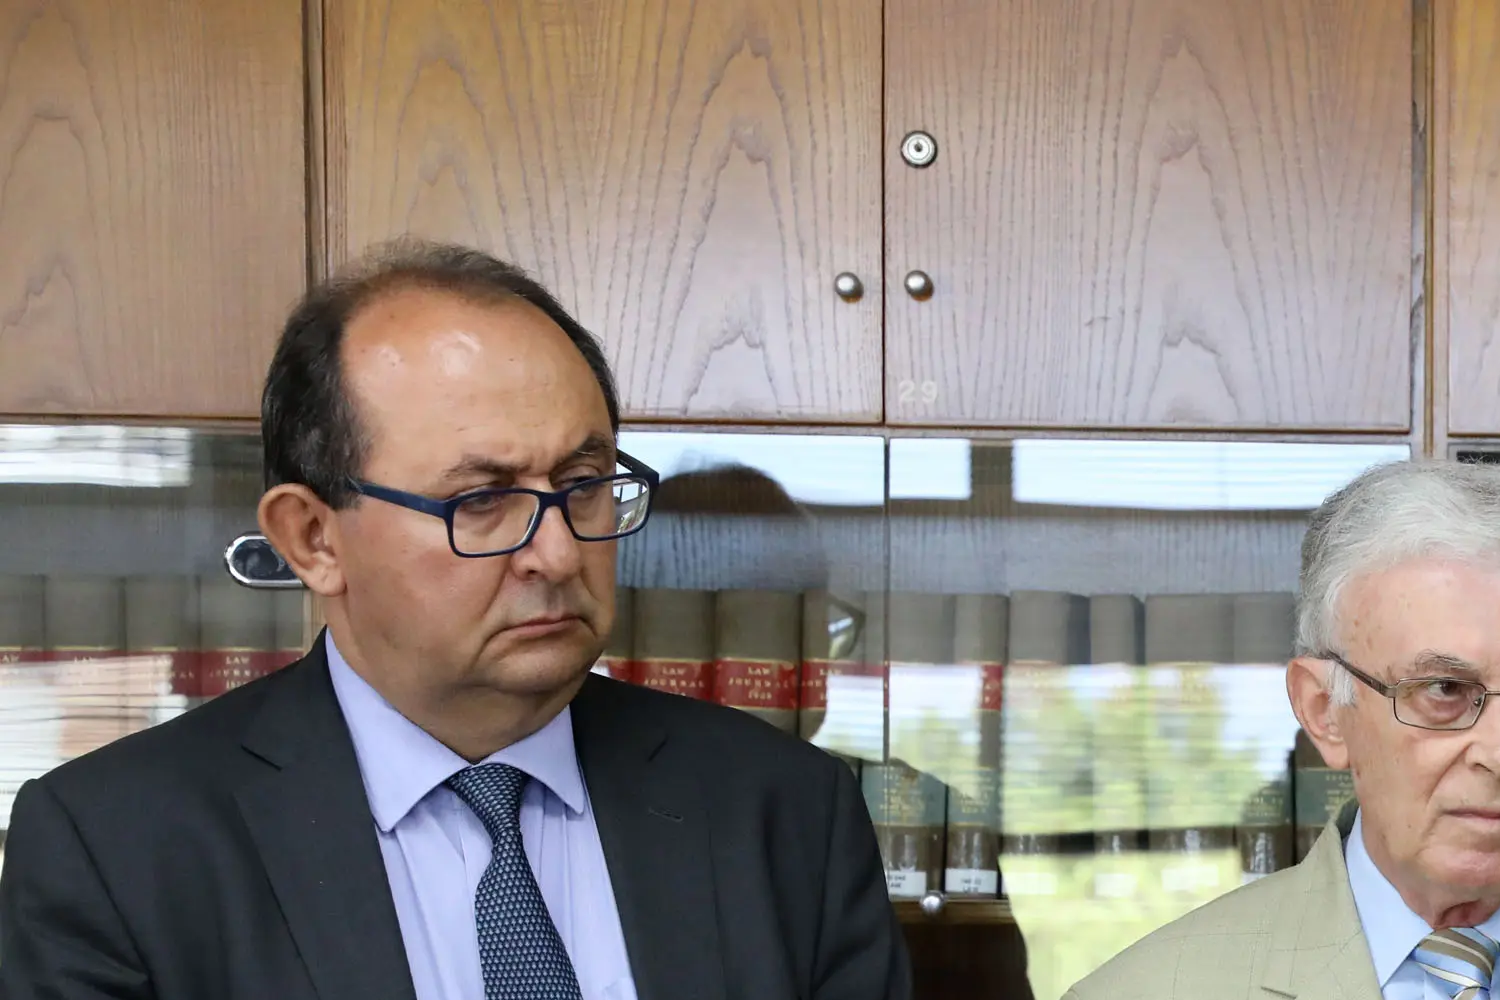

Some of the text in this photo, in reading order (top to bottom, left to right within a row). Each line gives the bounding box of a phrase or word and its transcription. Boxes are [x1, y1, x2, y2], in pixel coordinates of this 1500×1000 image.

[899, 380, 938, 403] 29
[226, 656, 250, 664] LAW
[662, 666, 686, 675] LAW
[747, 667, 771, 675] LAW
